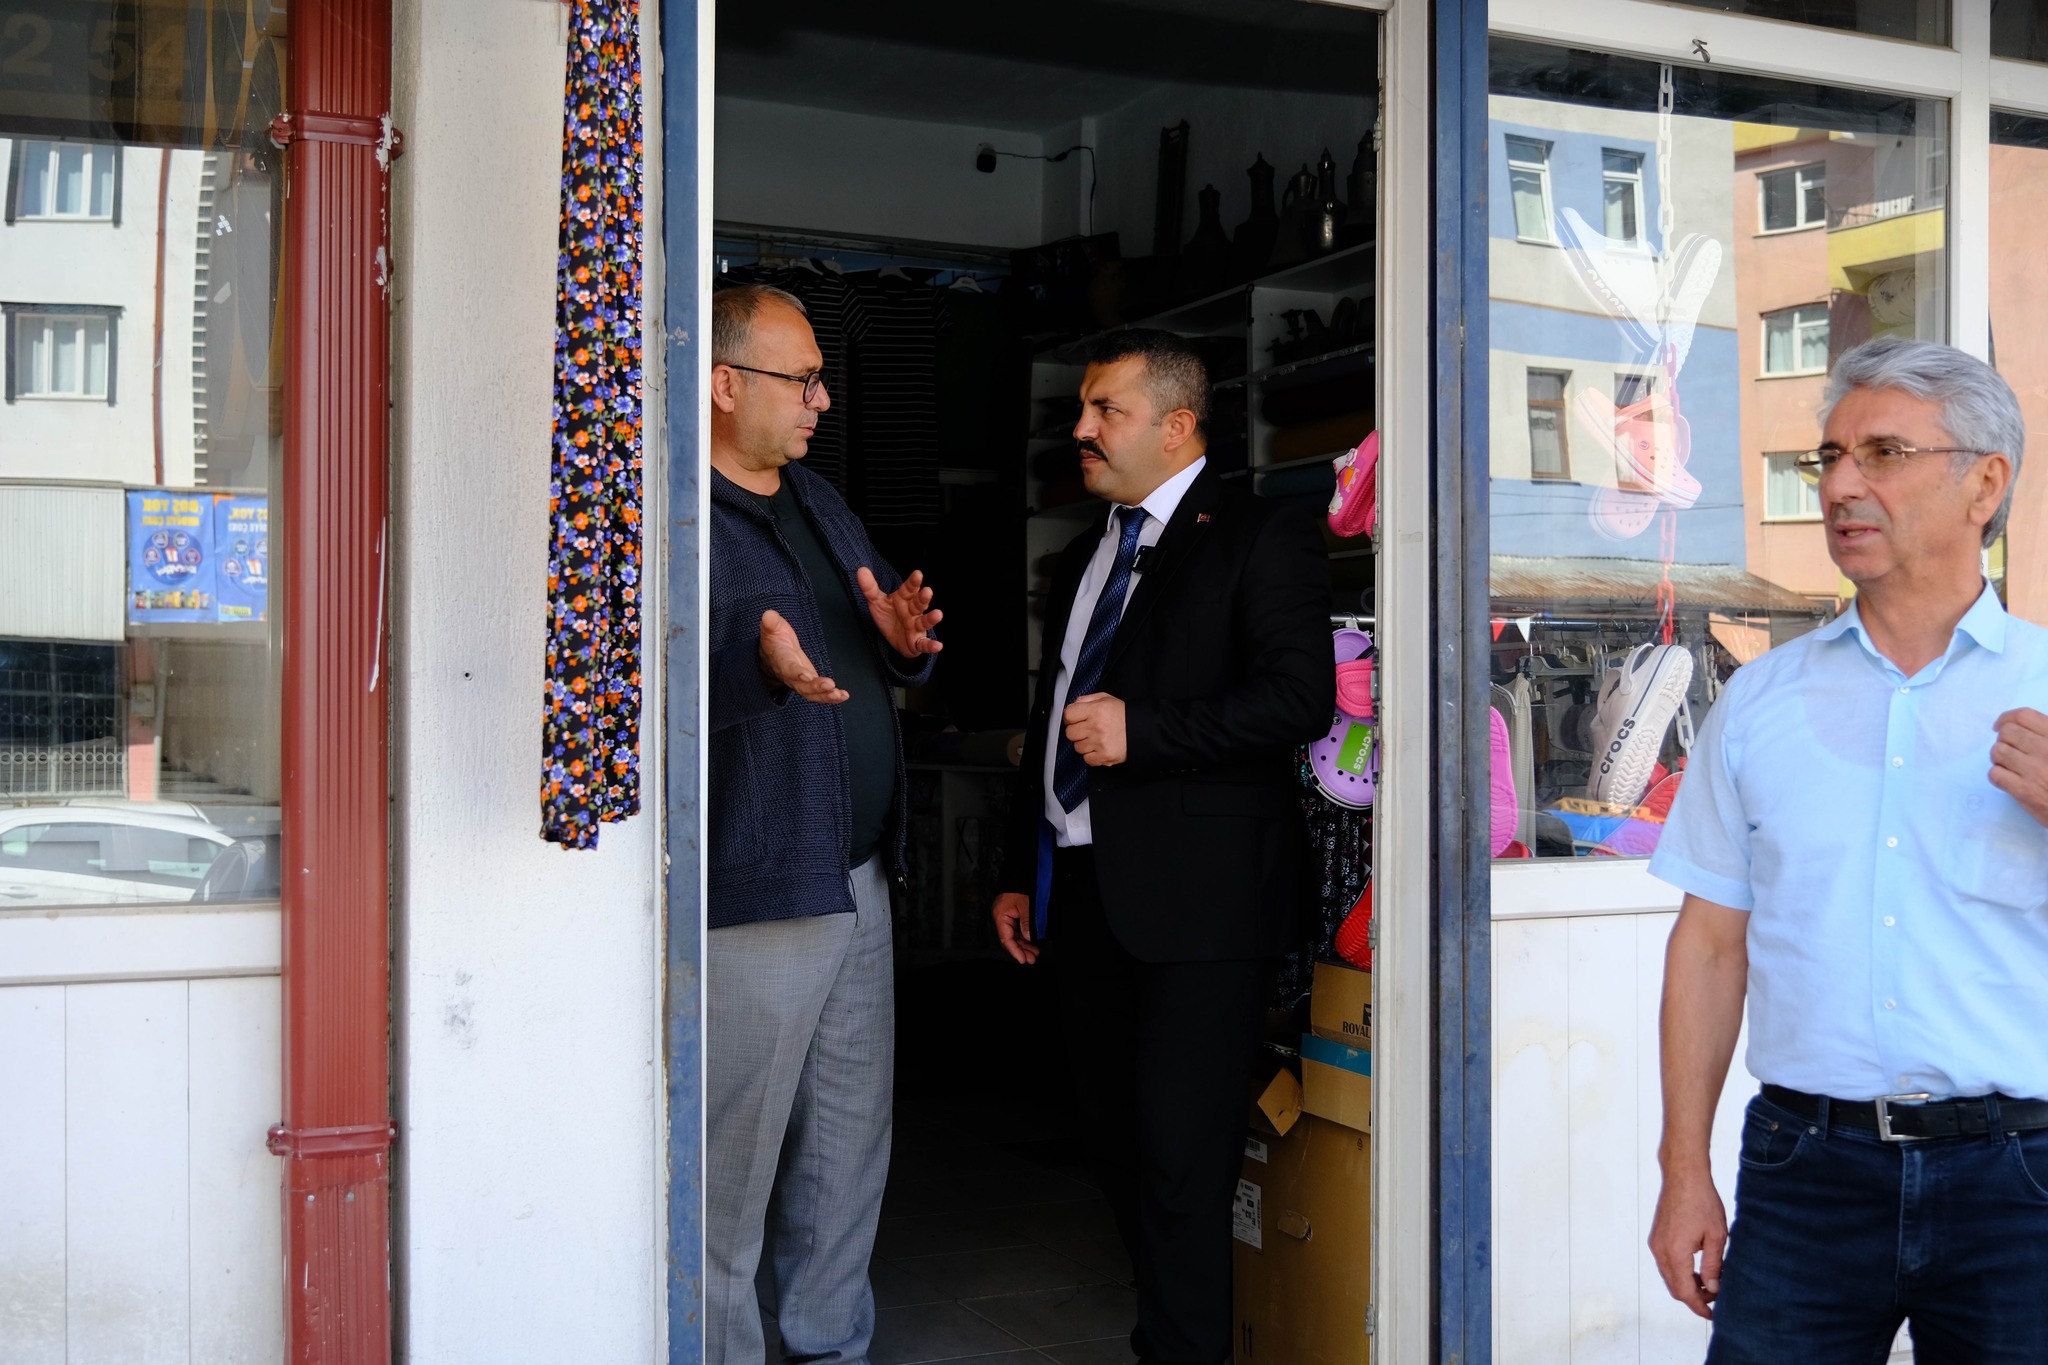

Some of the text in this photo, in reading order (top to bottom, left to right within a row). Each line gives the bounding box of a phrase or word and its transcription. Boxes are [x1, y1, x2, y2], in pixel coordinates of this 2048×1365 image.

[1353, 735, 1372, 771] crocs
[1599, 718, 1636, 775] crocs
[1342, 1020, 1371, 1038] ROYAL
